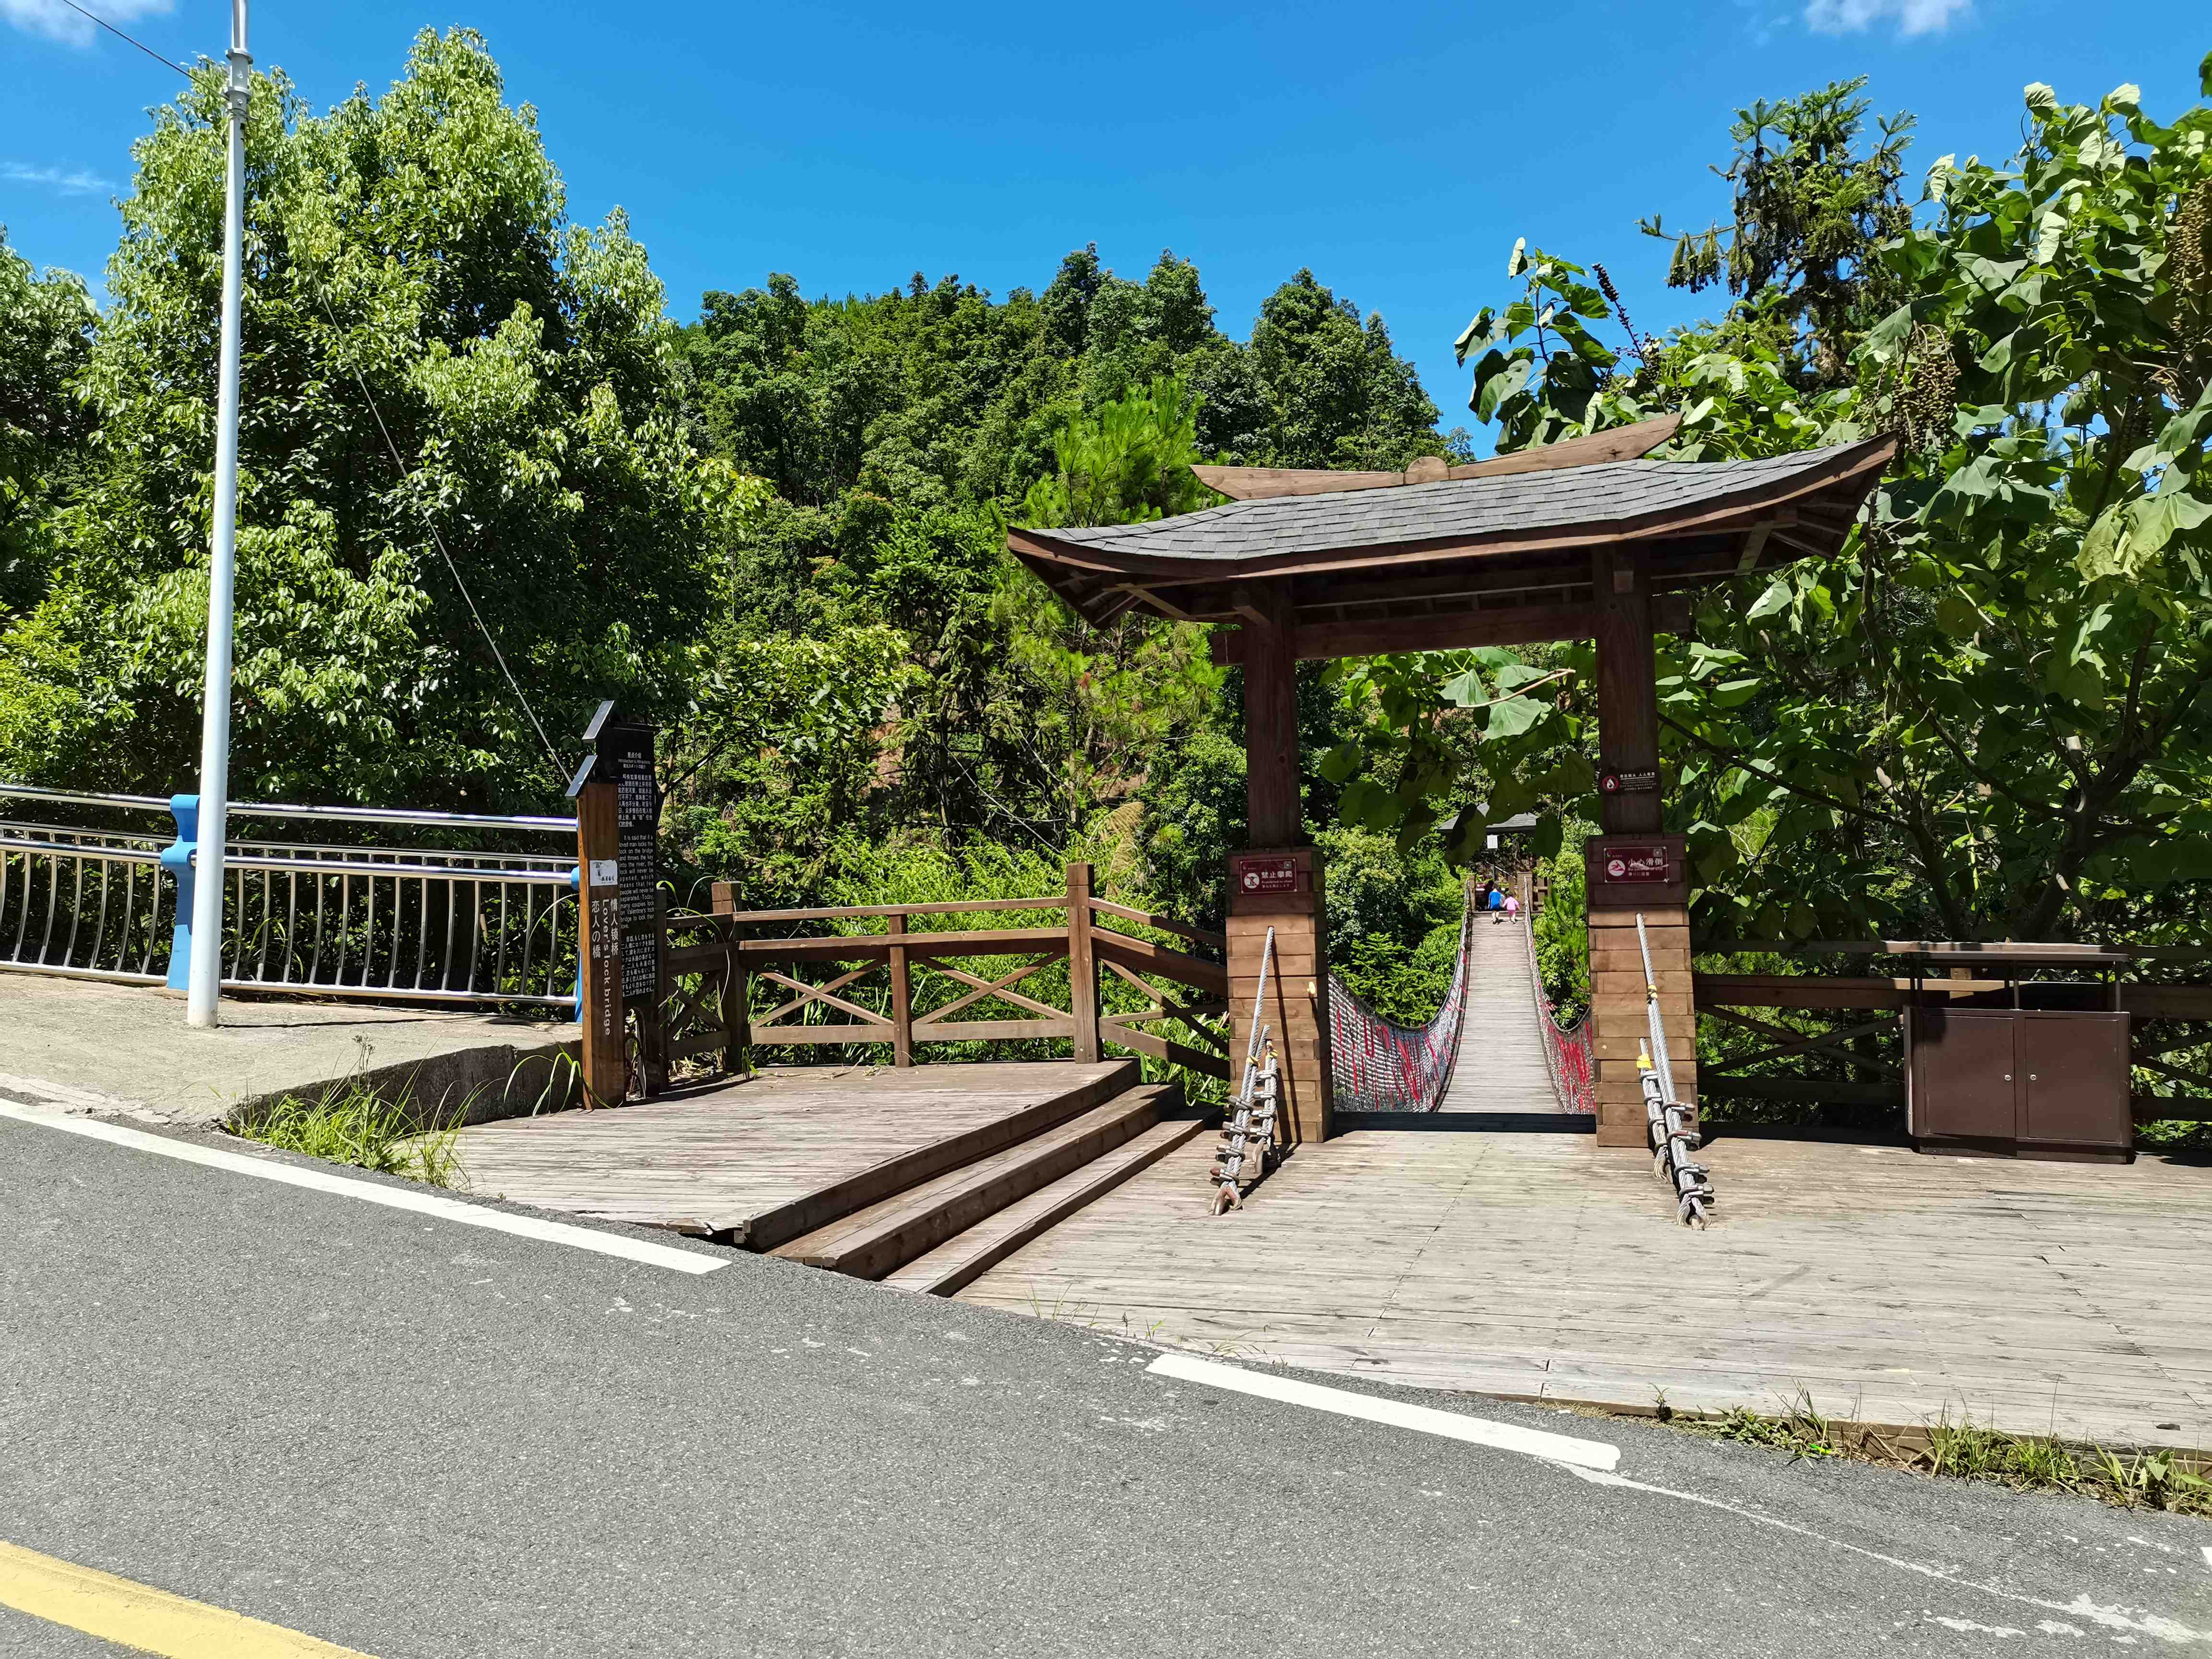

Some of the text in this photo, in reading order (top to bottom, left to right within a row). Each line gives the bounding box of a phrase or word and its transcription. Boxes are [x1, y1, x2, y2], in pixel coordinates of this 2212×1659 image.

[591, 900, 601, 959] 恋人の橋
[610, 898, 619, 957] 情人锁桥
[603, 988, 612, 1035] bridge
